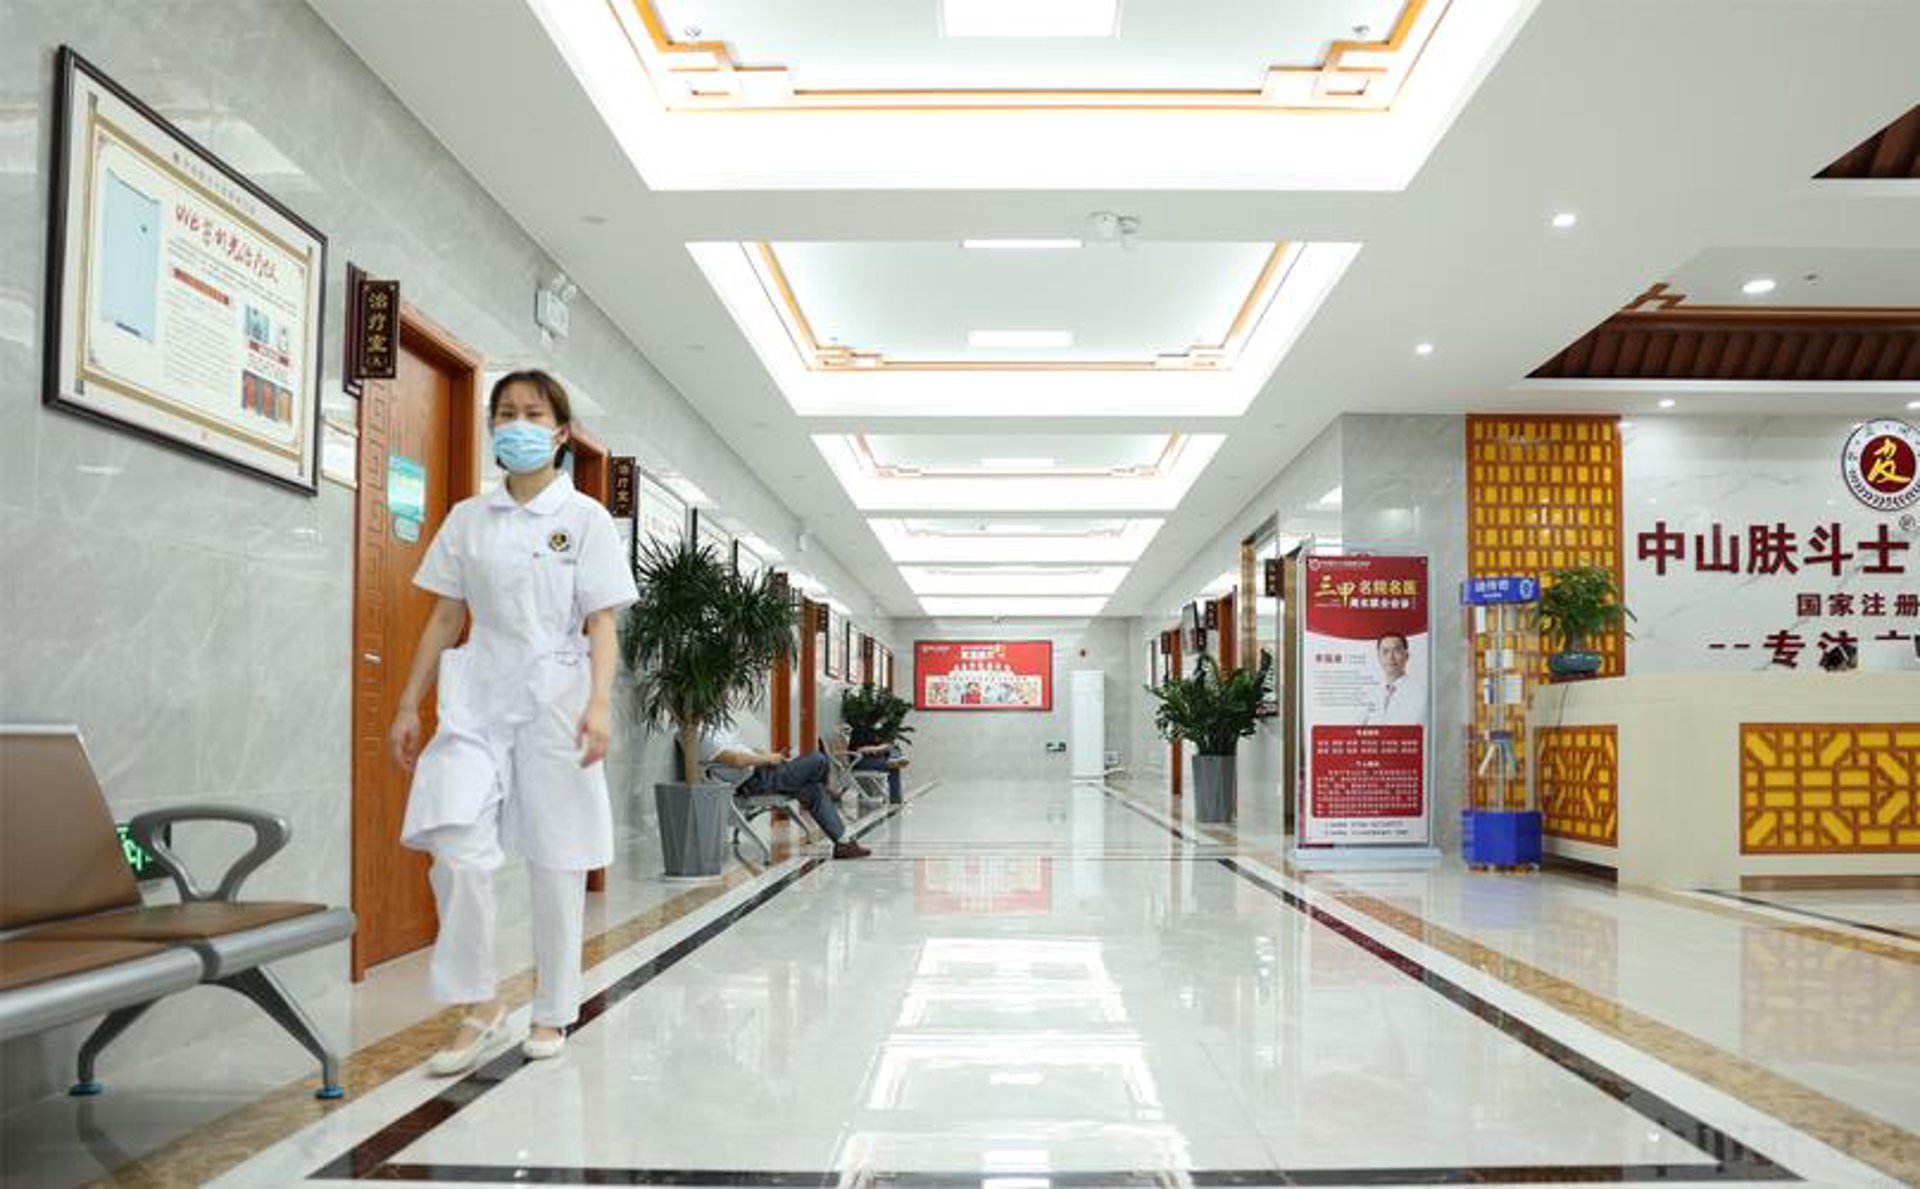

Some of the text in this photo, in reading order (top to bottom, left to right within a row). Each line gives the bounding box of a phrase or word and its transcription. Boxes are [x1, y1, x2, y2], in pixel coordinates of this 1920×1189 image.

[367, 291, 389, 354] 治疗室
[1637, 521, 1910, 577] 中山肤斗士
[1796, 592, 1920, 617] 国家注册
